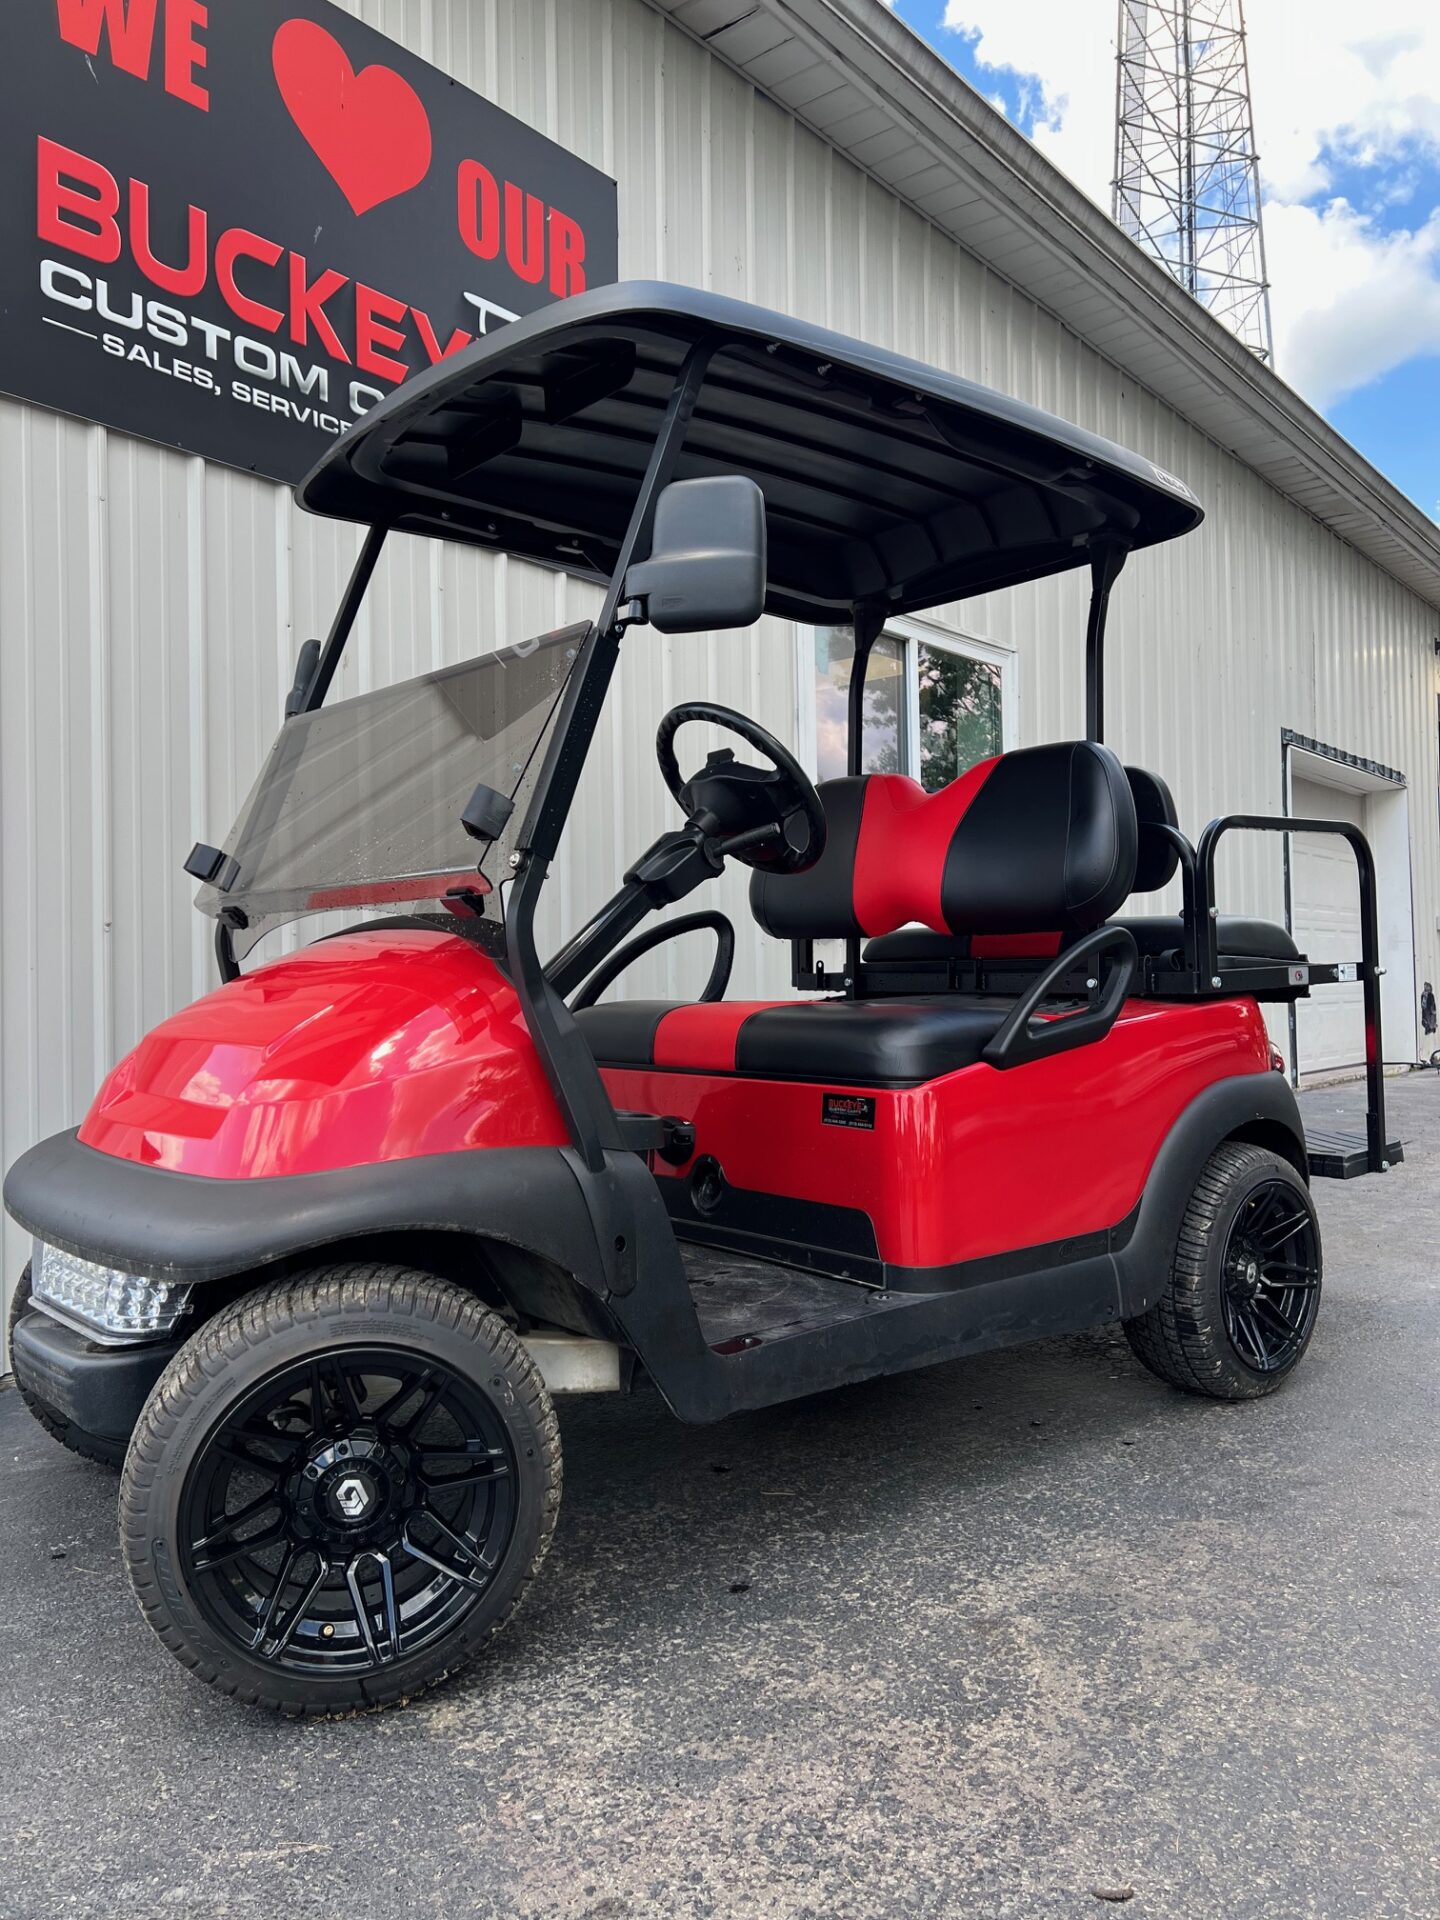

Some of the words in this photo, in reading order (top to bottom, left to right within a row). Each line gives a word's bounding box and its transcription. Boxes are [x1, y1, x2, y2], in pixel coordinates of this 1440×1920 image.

[56, 0, 209, 112] WE
[458, 159, 586, 300] OUR
[37, 134, 480, 385] BUCKEY
[40, 259, 329, 402] CUSTOM
[102, 333, 221, 396] SALES,
